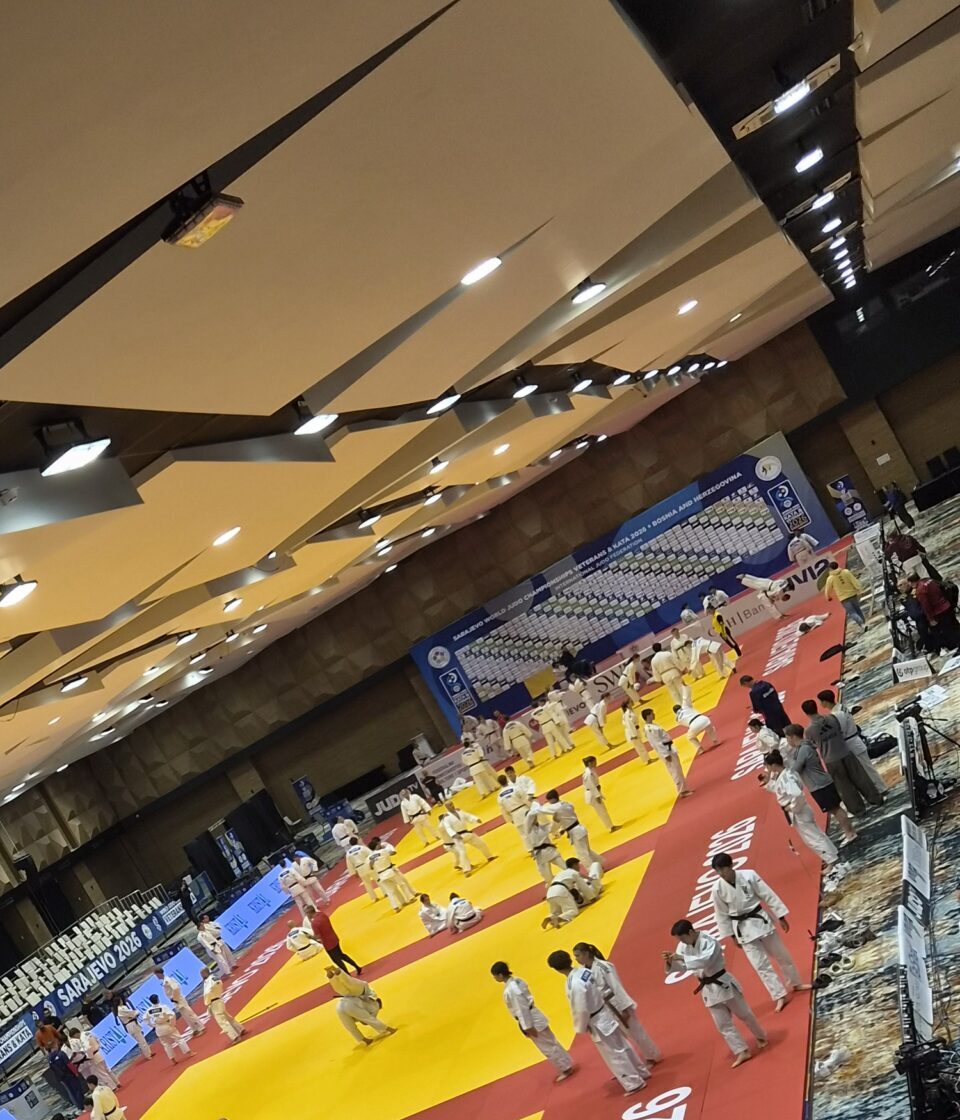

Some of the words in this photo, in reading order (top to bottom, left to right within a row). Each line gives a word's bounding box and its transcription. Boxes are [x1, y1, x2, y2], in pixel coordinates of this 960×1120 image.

[453, 620, 484, 642] SARAJEVO
[484, 608, 506, 625] WORLD
[507, 598, 523, 613] JUDO
[523, 569, 574, 601] CHAMPIONSHIPS
[574, 550, 607, 573] VETERANS
[612, 537, 629, 550] KATA
[652, 509, 678, 527] BOSNIA
[678, 500, 693, 513] AND
[693, 471, 742, 504] HERZEGOVINA
[57, 953, 117, 1006] SARAJEVO
[114, 931, 142, 962] 2026
[16, 1029, 32, 1046] KATA
